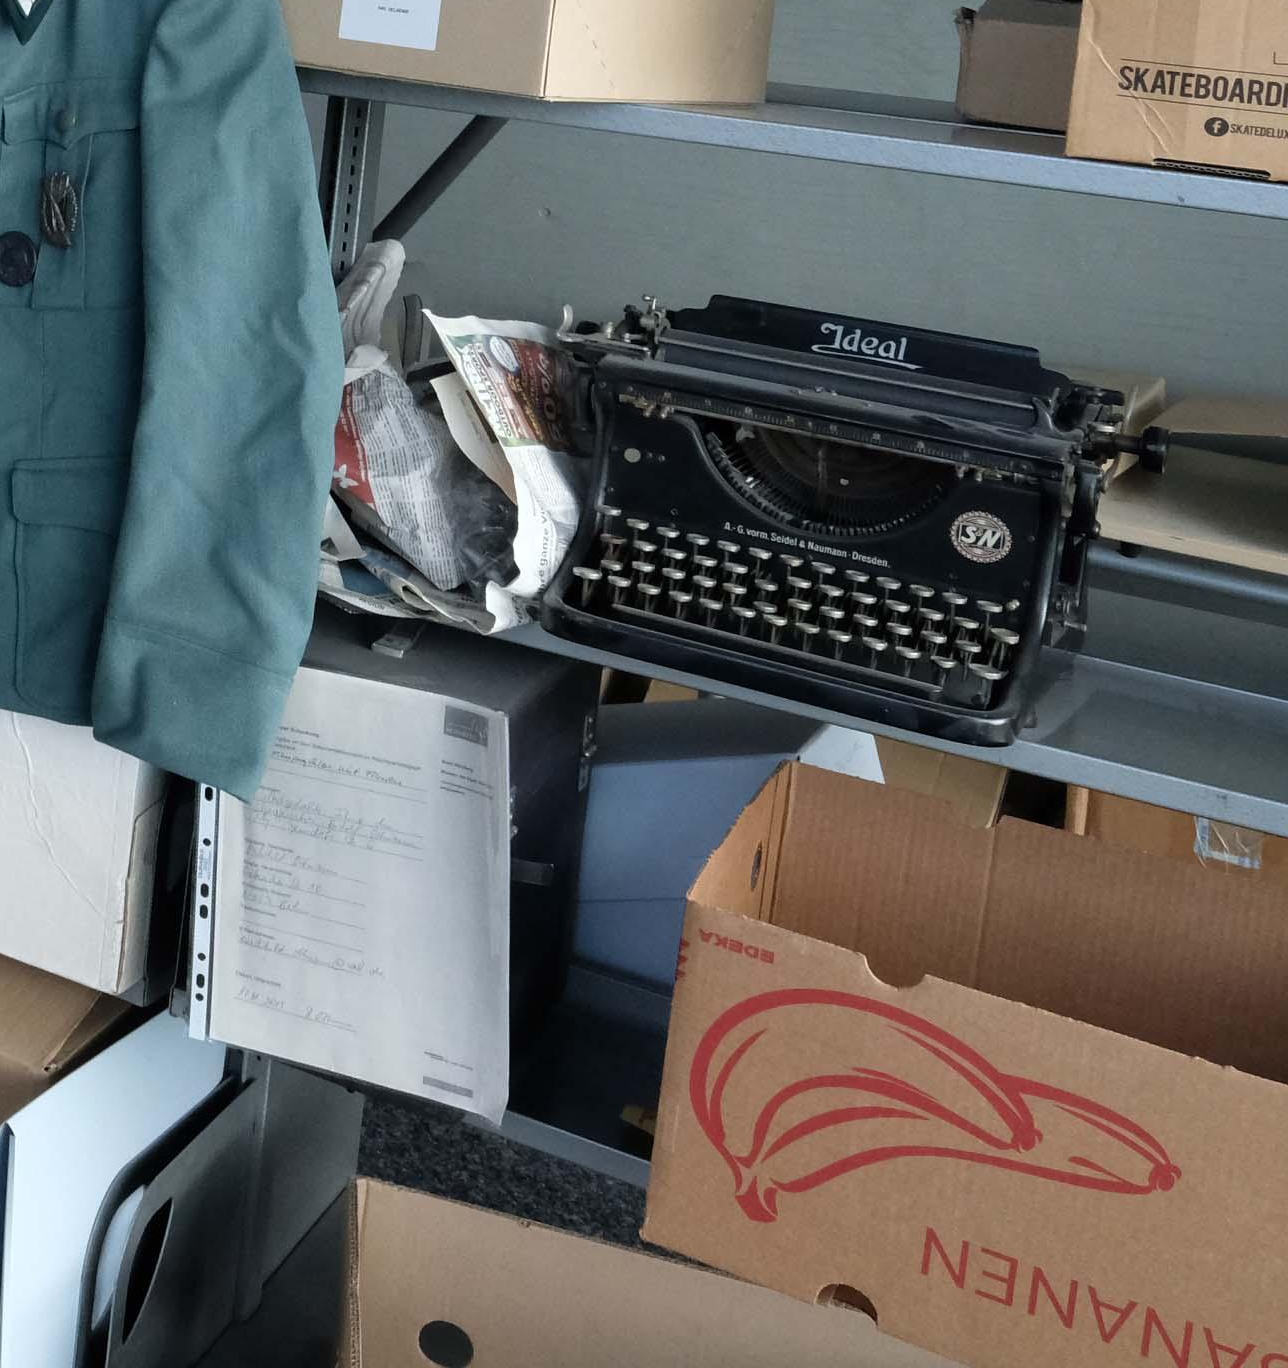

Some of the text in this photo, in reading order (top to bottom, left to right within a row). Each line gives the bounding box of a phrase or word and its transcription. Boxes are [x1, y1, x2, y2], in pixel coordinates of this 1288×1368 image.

[813, 322, 913, 365] Ideal
[770, 532, 798, 547] Seidel
[807, 541, 847, 559] Naumann
[699, 928, 774, 963] EDEKA
